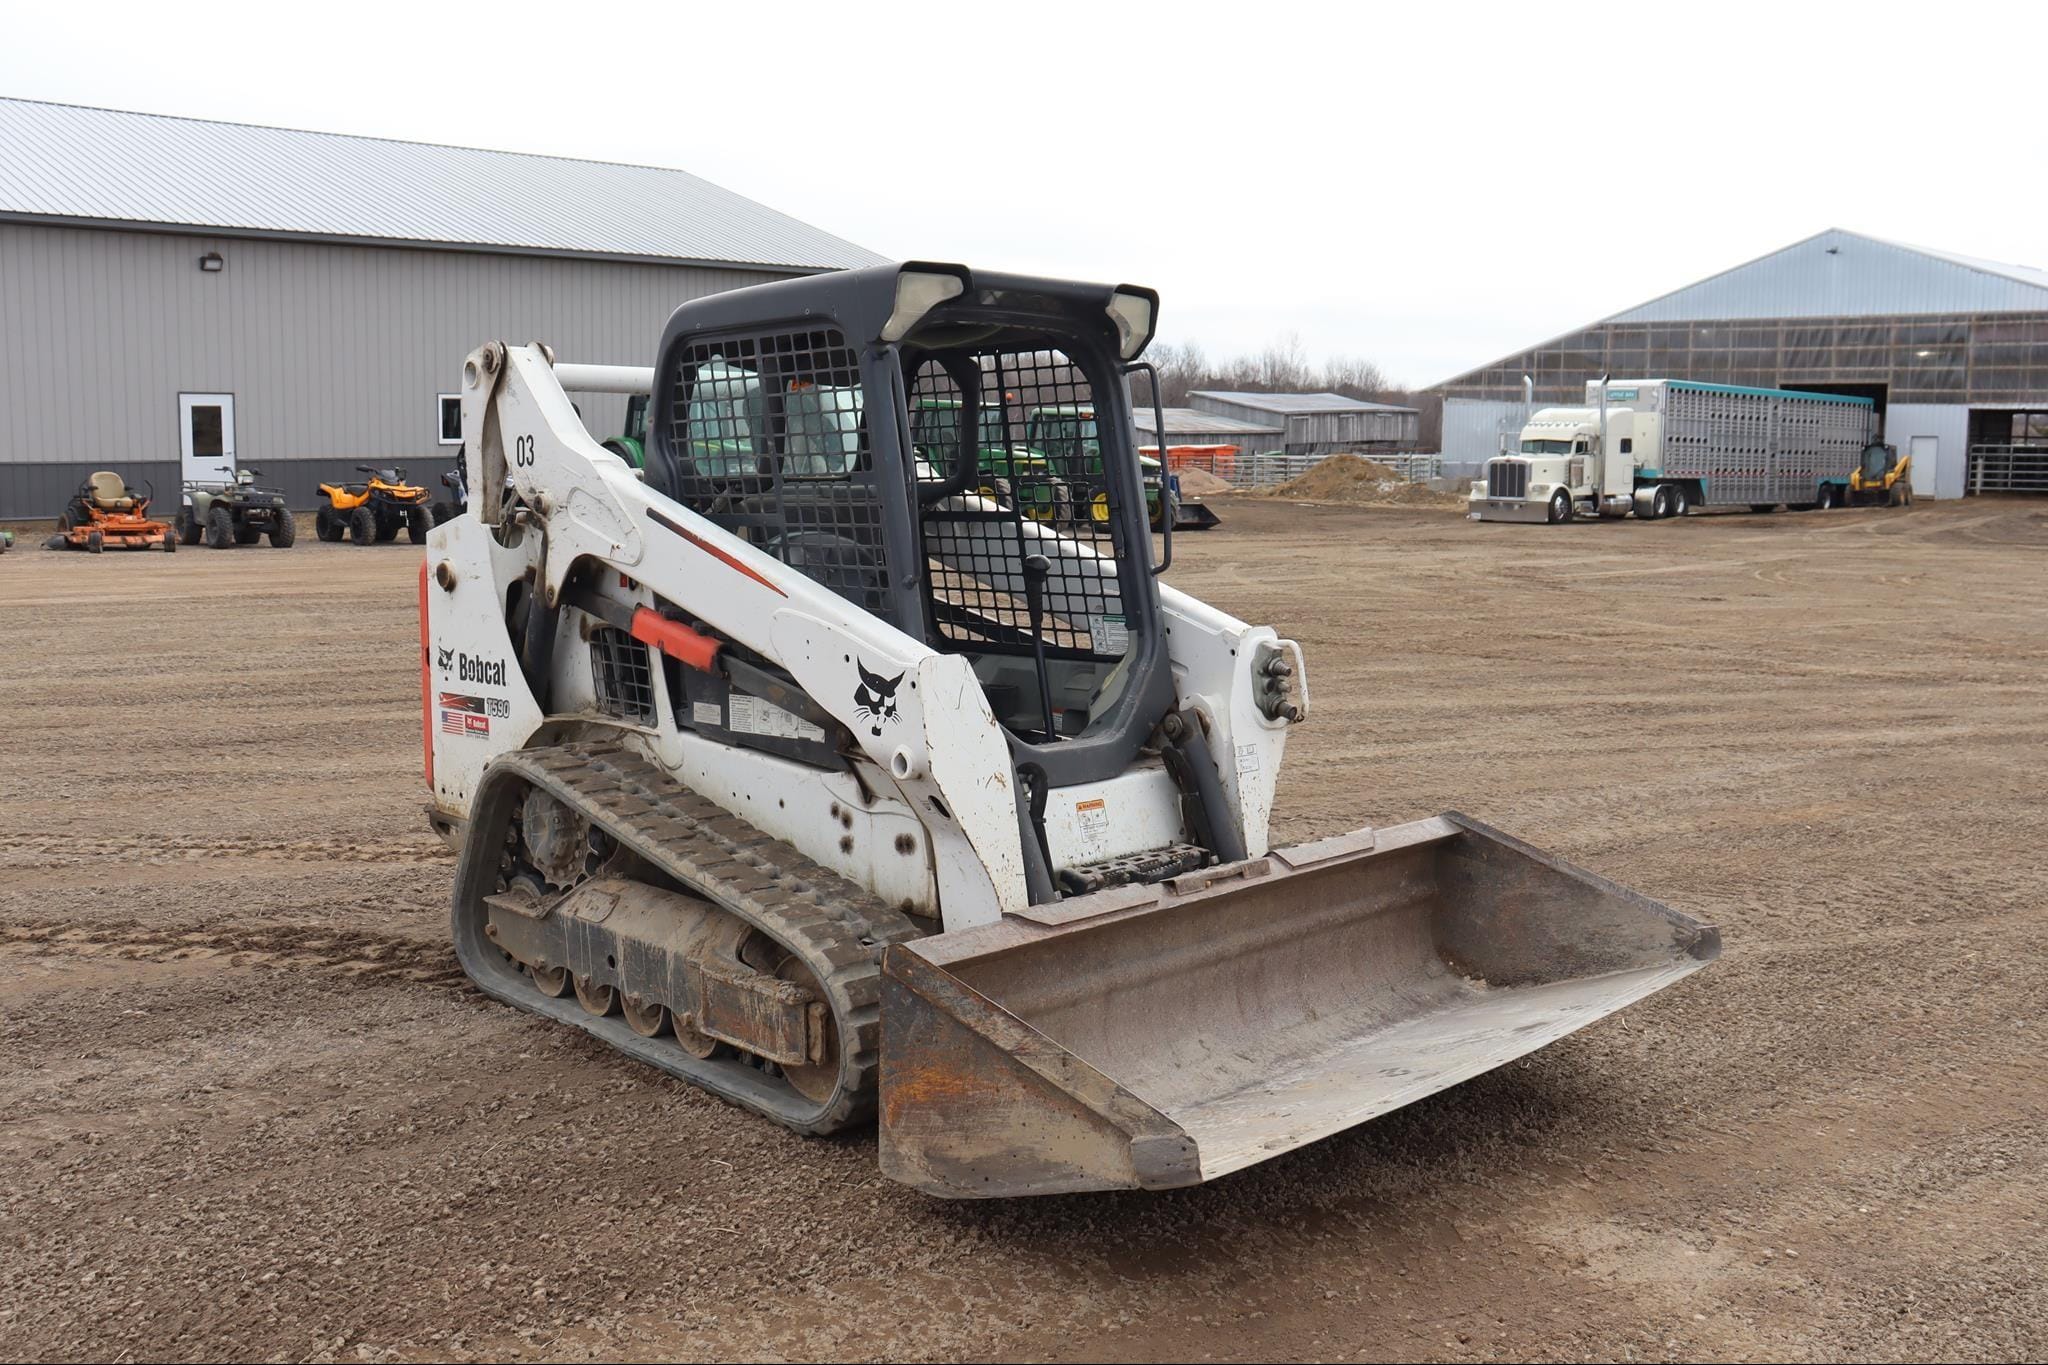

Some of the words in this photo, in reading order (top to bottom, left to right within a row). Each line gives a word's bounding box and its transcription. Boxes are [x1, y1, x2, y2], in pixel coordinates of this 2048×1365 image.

[516, 434, 535, 468] 03
[459, 653, 506, 686] Bobcat
[1082, 801, 1103, 809] WARNING
